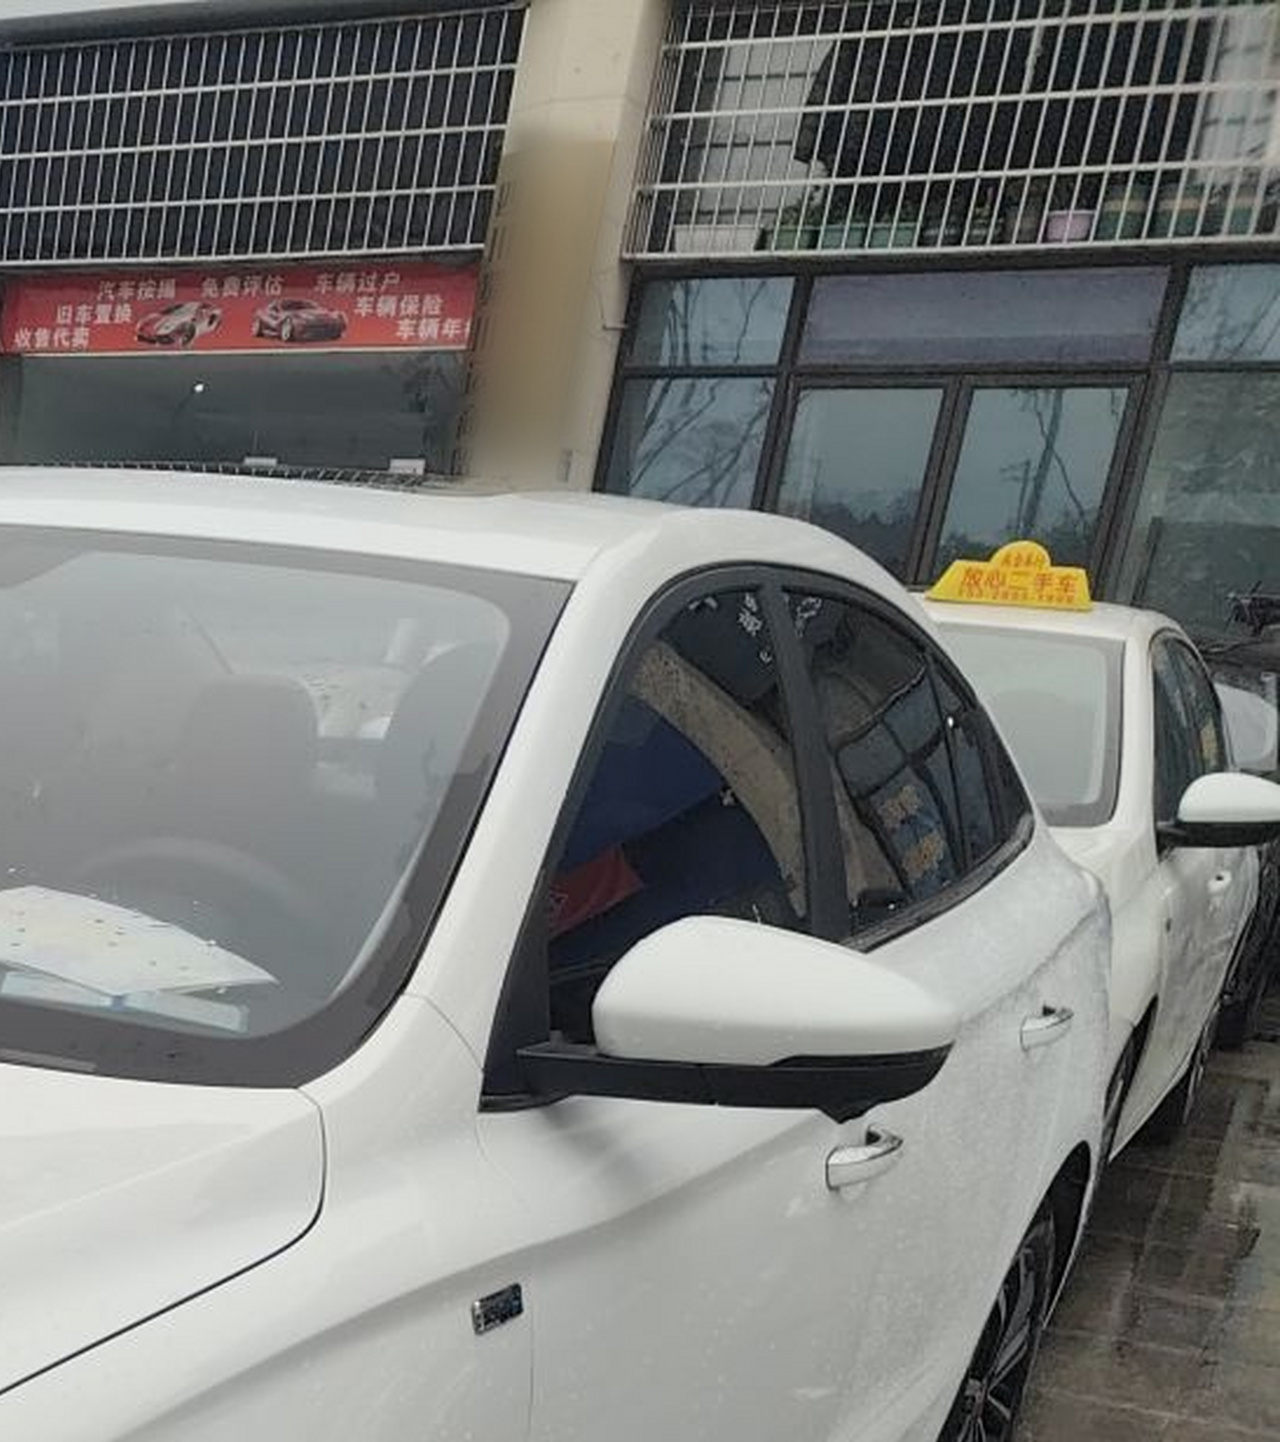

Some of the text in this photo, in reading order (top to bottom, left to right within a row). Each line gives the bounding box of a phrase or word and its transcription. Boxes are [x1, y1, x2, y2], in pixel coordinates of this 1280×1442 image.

[201, 274, 284, 298] 免费评估
[313, 272, 401, 294] 车辆过户
[56, 303, 132, 324] 旧车置换
[353, 295, 443, 317] 车辆保险
